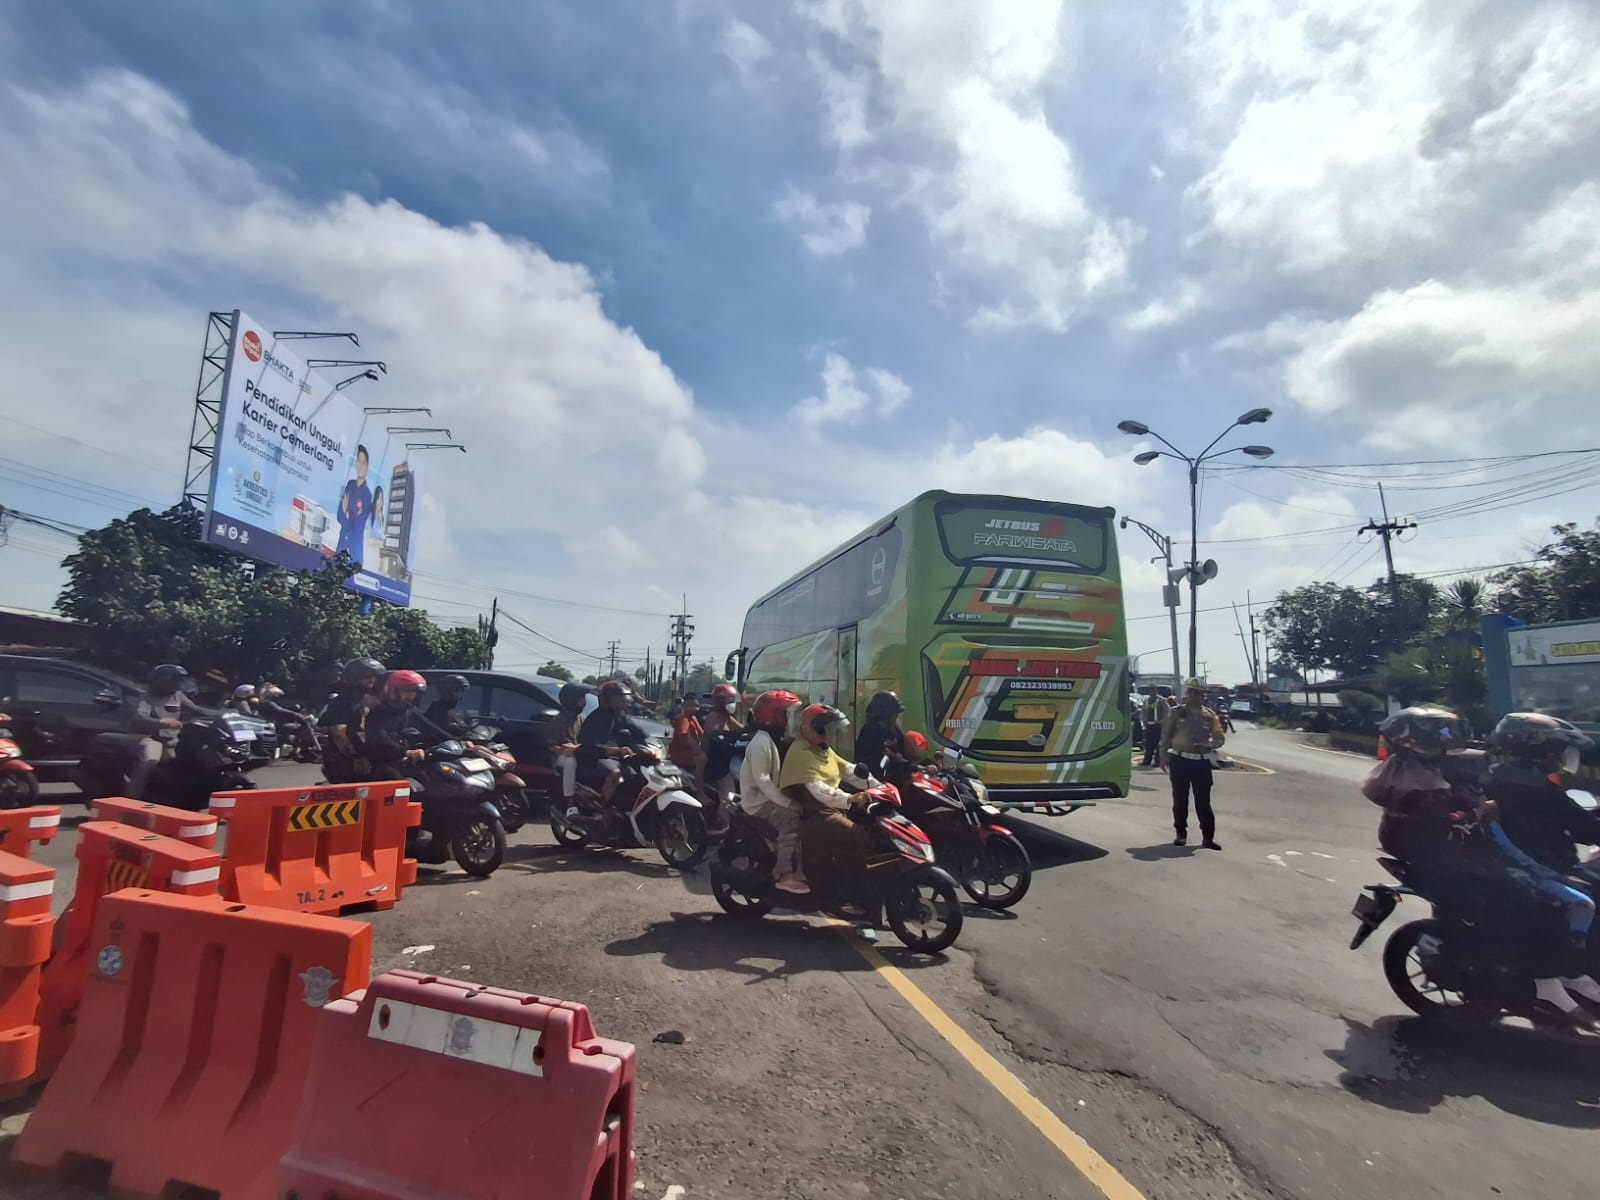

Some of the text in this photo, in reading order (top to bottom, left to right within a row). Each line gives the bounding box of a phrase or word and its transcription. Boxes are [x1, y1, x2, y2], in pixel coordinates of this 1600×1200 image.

[264, 350, 294, 380] BHAKTA
[245, 378, 343, 457] Pendidikan Unggul,
[242, 400, 334, 471] Karier Cemerlang
[985, 519, 1040, 532] JETBUS
[974, 533, 1076, 552] PARIWISATA
